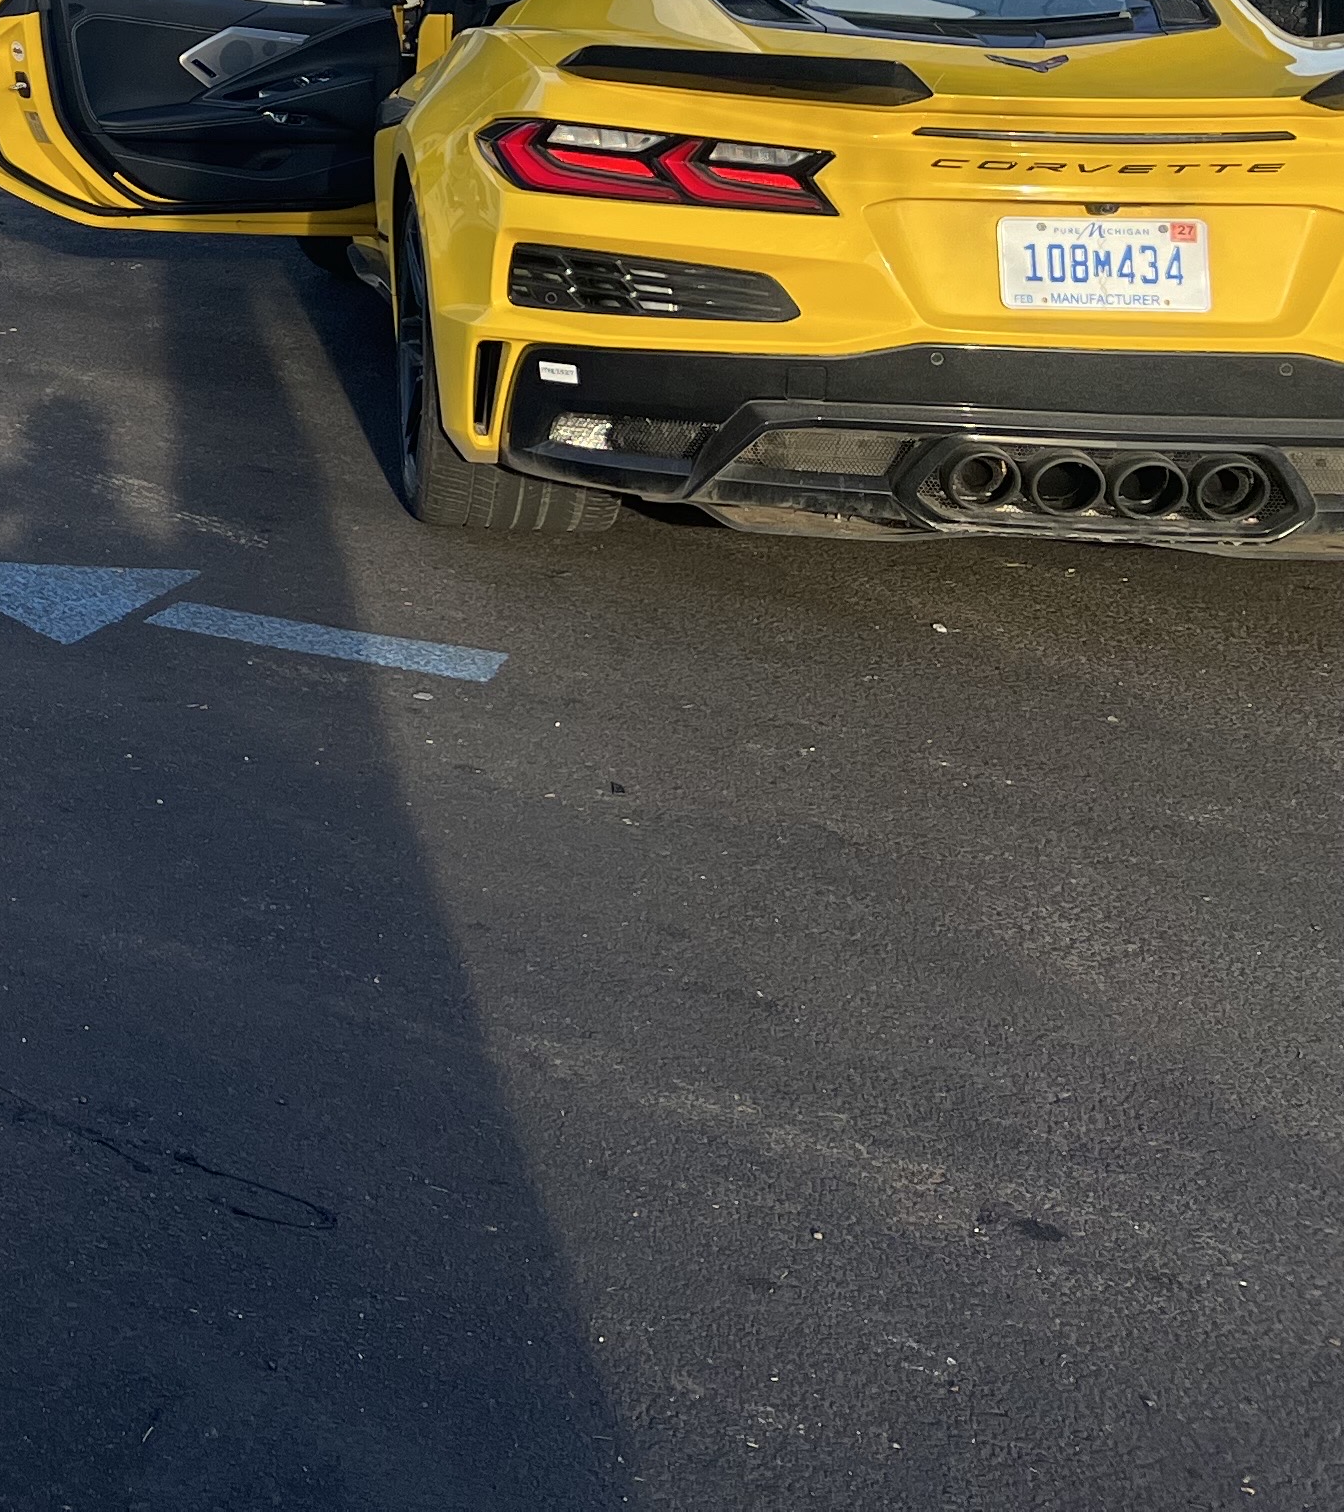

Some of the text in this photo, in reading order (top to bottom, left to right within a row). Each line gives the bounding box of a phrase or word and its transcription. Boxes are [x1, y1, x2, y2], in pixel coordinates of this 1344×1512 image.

[931, 158, 1287, 174] CORVETTE
[1053, 226, 1080, 236] PURE
[1177, 225, 1195, 236] 27
[1023, 243, 1184, 286] 108M434
[1014, 293, 1161, 306] FEB MANUFACTURER
